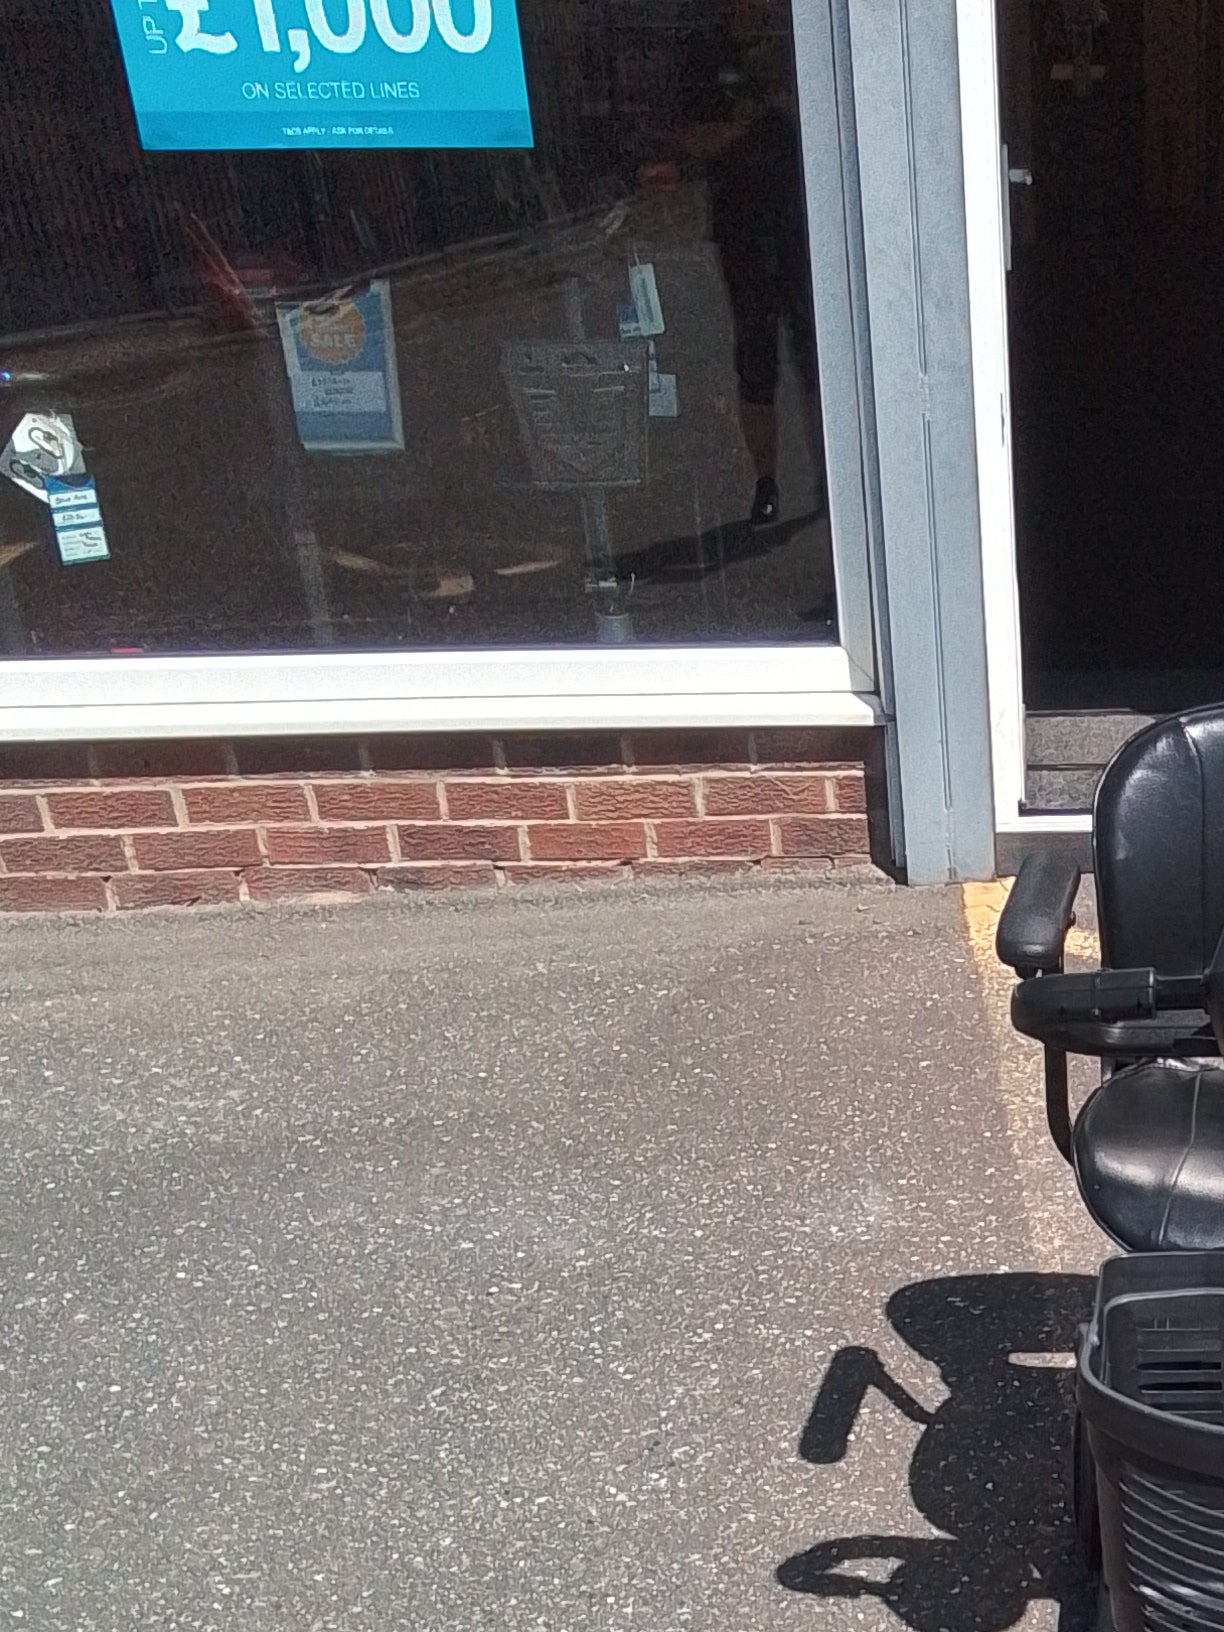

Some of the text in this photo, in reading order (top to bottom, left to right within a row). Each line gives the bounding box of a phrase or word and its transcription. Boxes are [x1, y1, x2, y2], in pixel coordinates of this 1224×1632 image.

[142, 15, 168, 54] UP
[242, 81, 420, 99] ON SELECTED LINES
